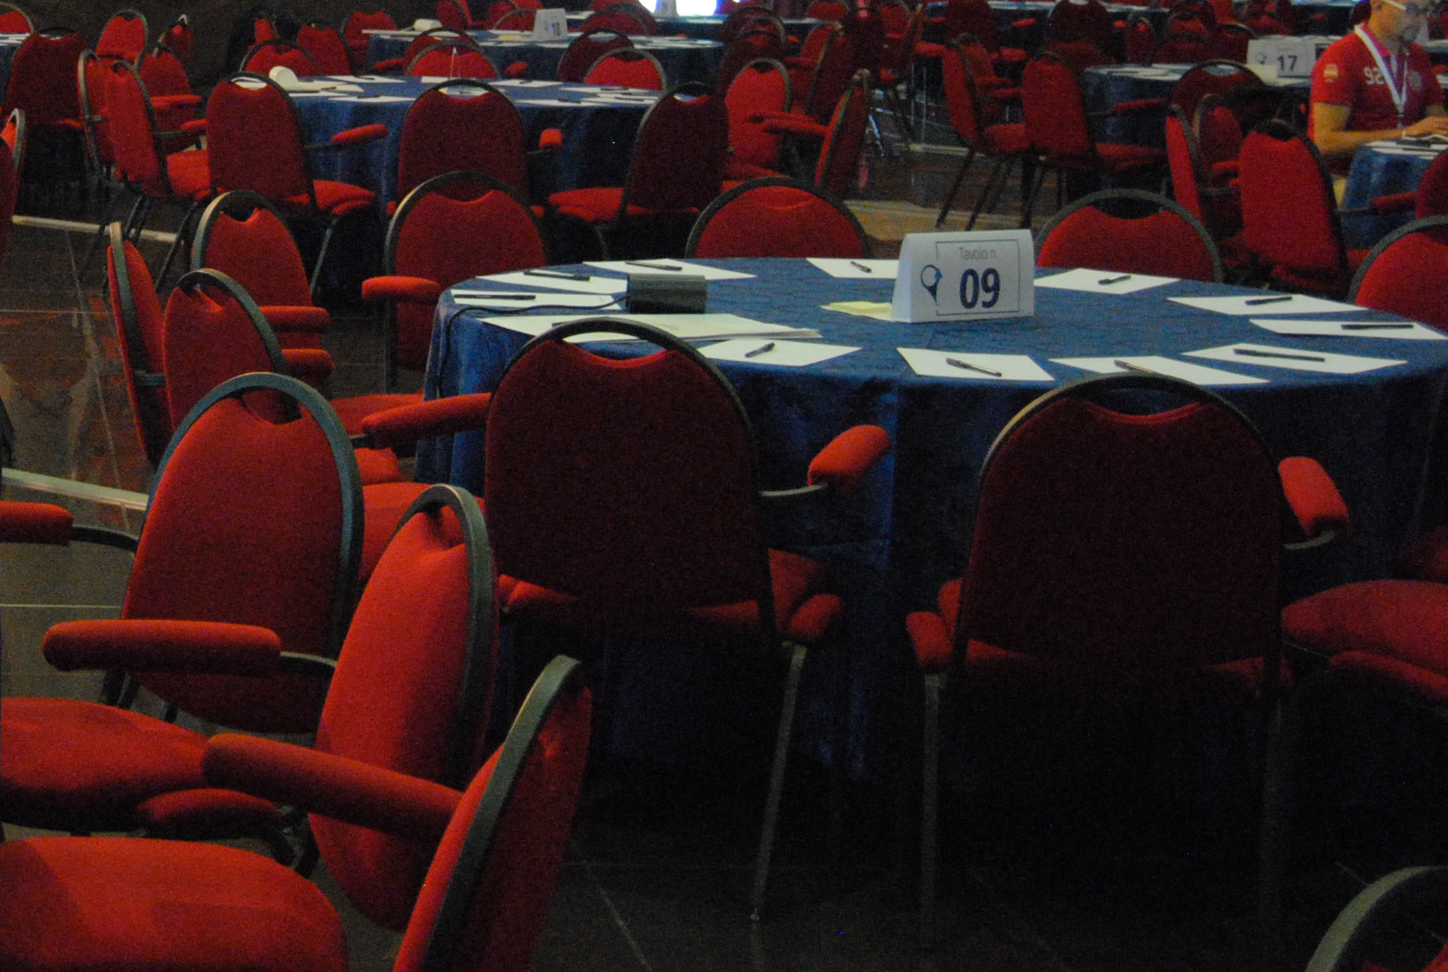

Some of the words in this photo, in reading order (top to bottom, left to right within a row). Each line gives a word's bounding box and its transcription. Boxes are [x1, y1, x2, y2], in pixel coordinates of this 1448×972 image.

[1277, 54, 1298, 71] 17
[958, 246, 988, 260] Tavolo
[959, 267, 1001, 310] 09
